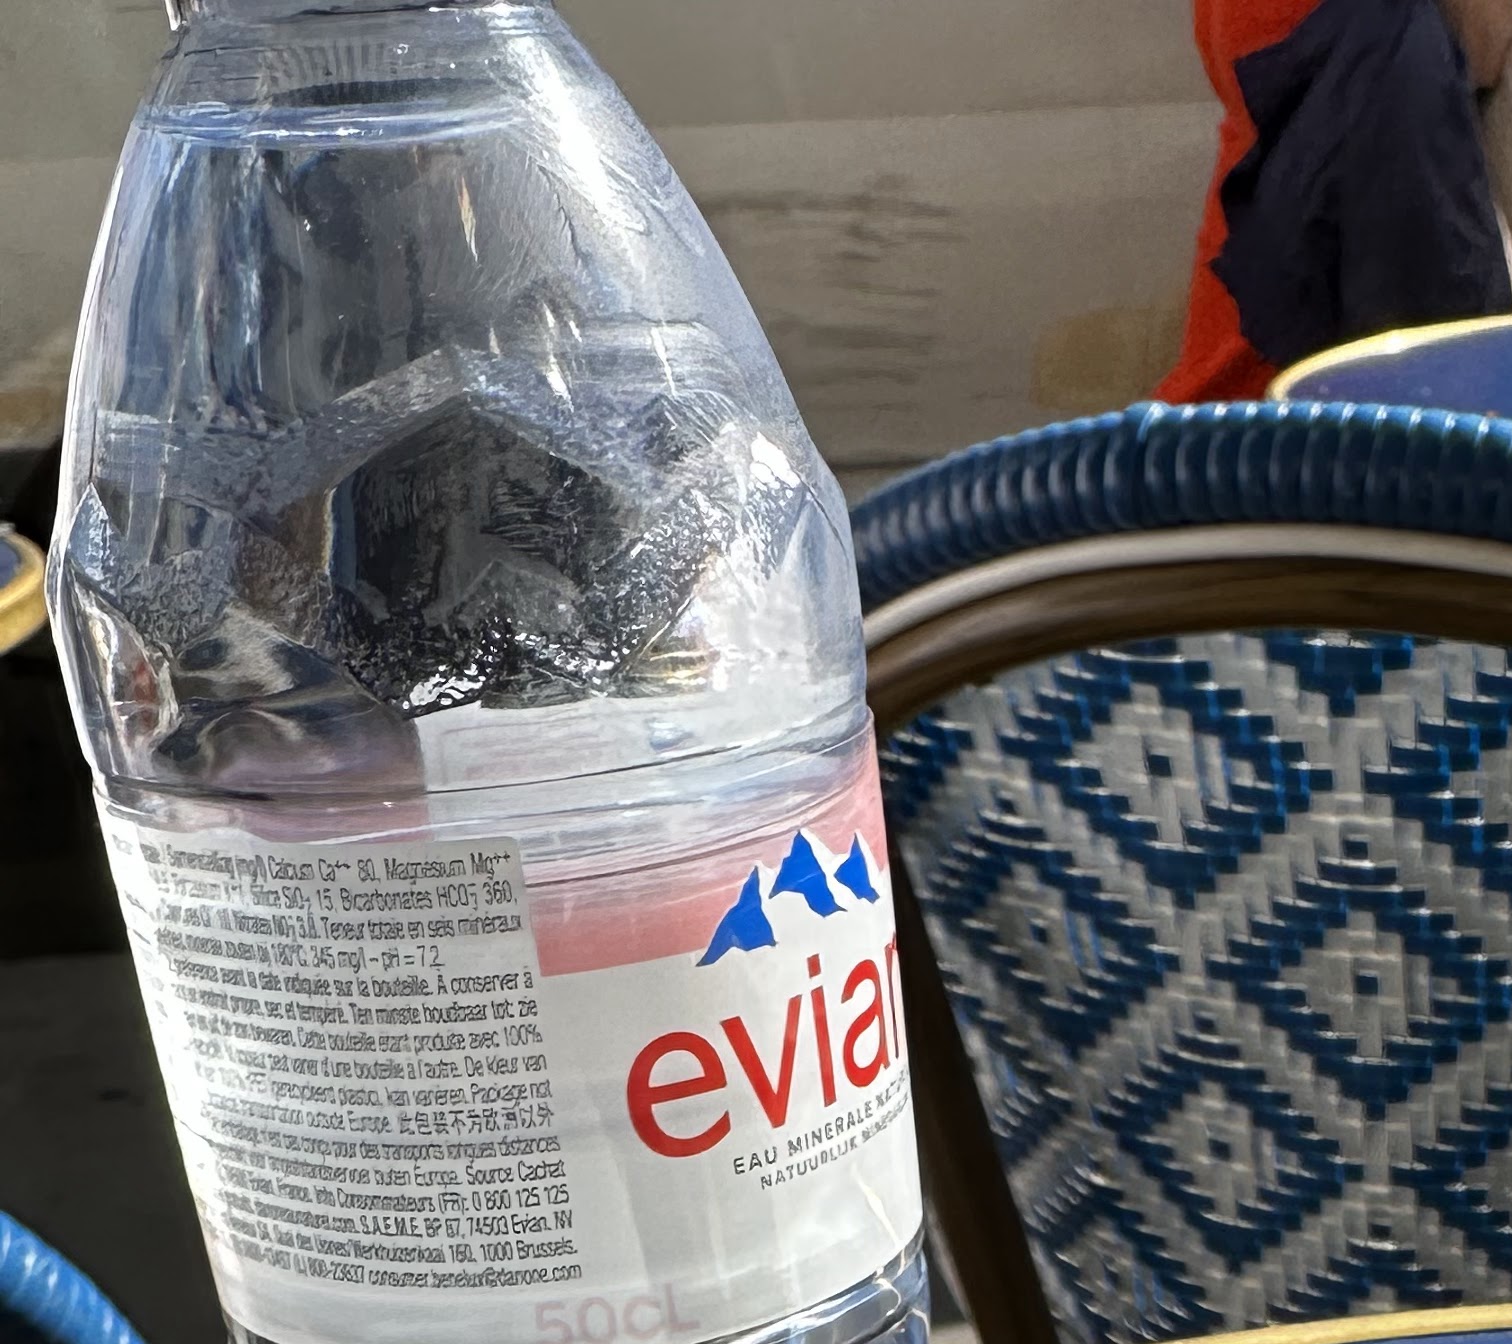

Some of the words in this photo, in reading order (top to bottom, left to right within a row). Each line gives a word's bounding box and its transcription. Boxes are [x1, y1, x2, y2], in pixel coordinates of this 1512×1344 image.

[733, 1145, 778, 1176] EAU
[514, 1187, 542, 1208] 125
[543, 1184, 571, 1206] 125
